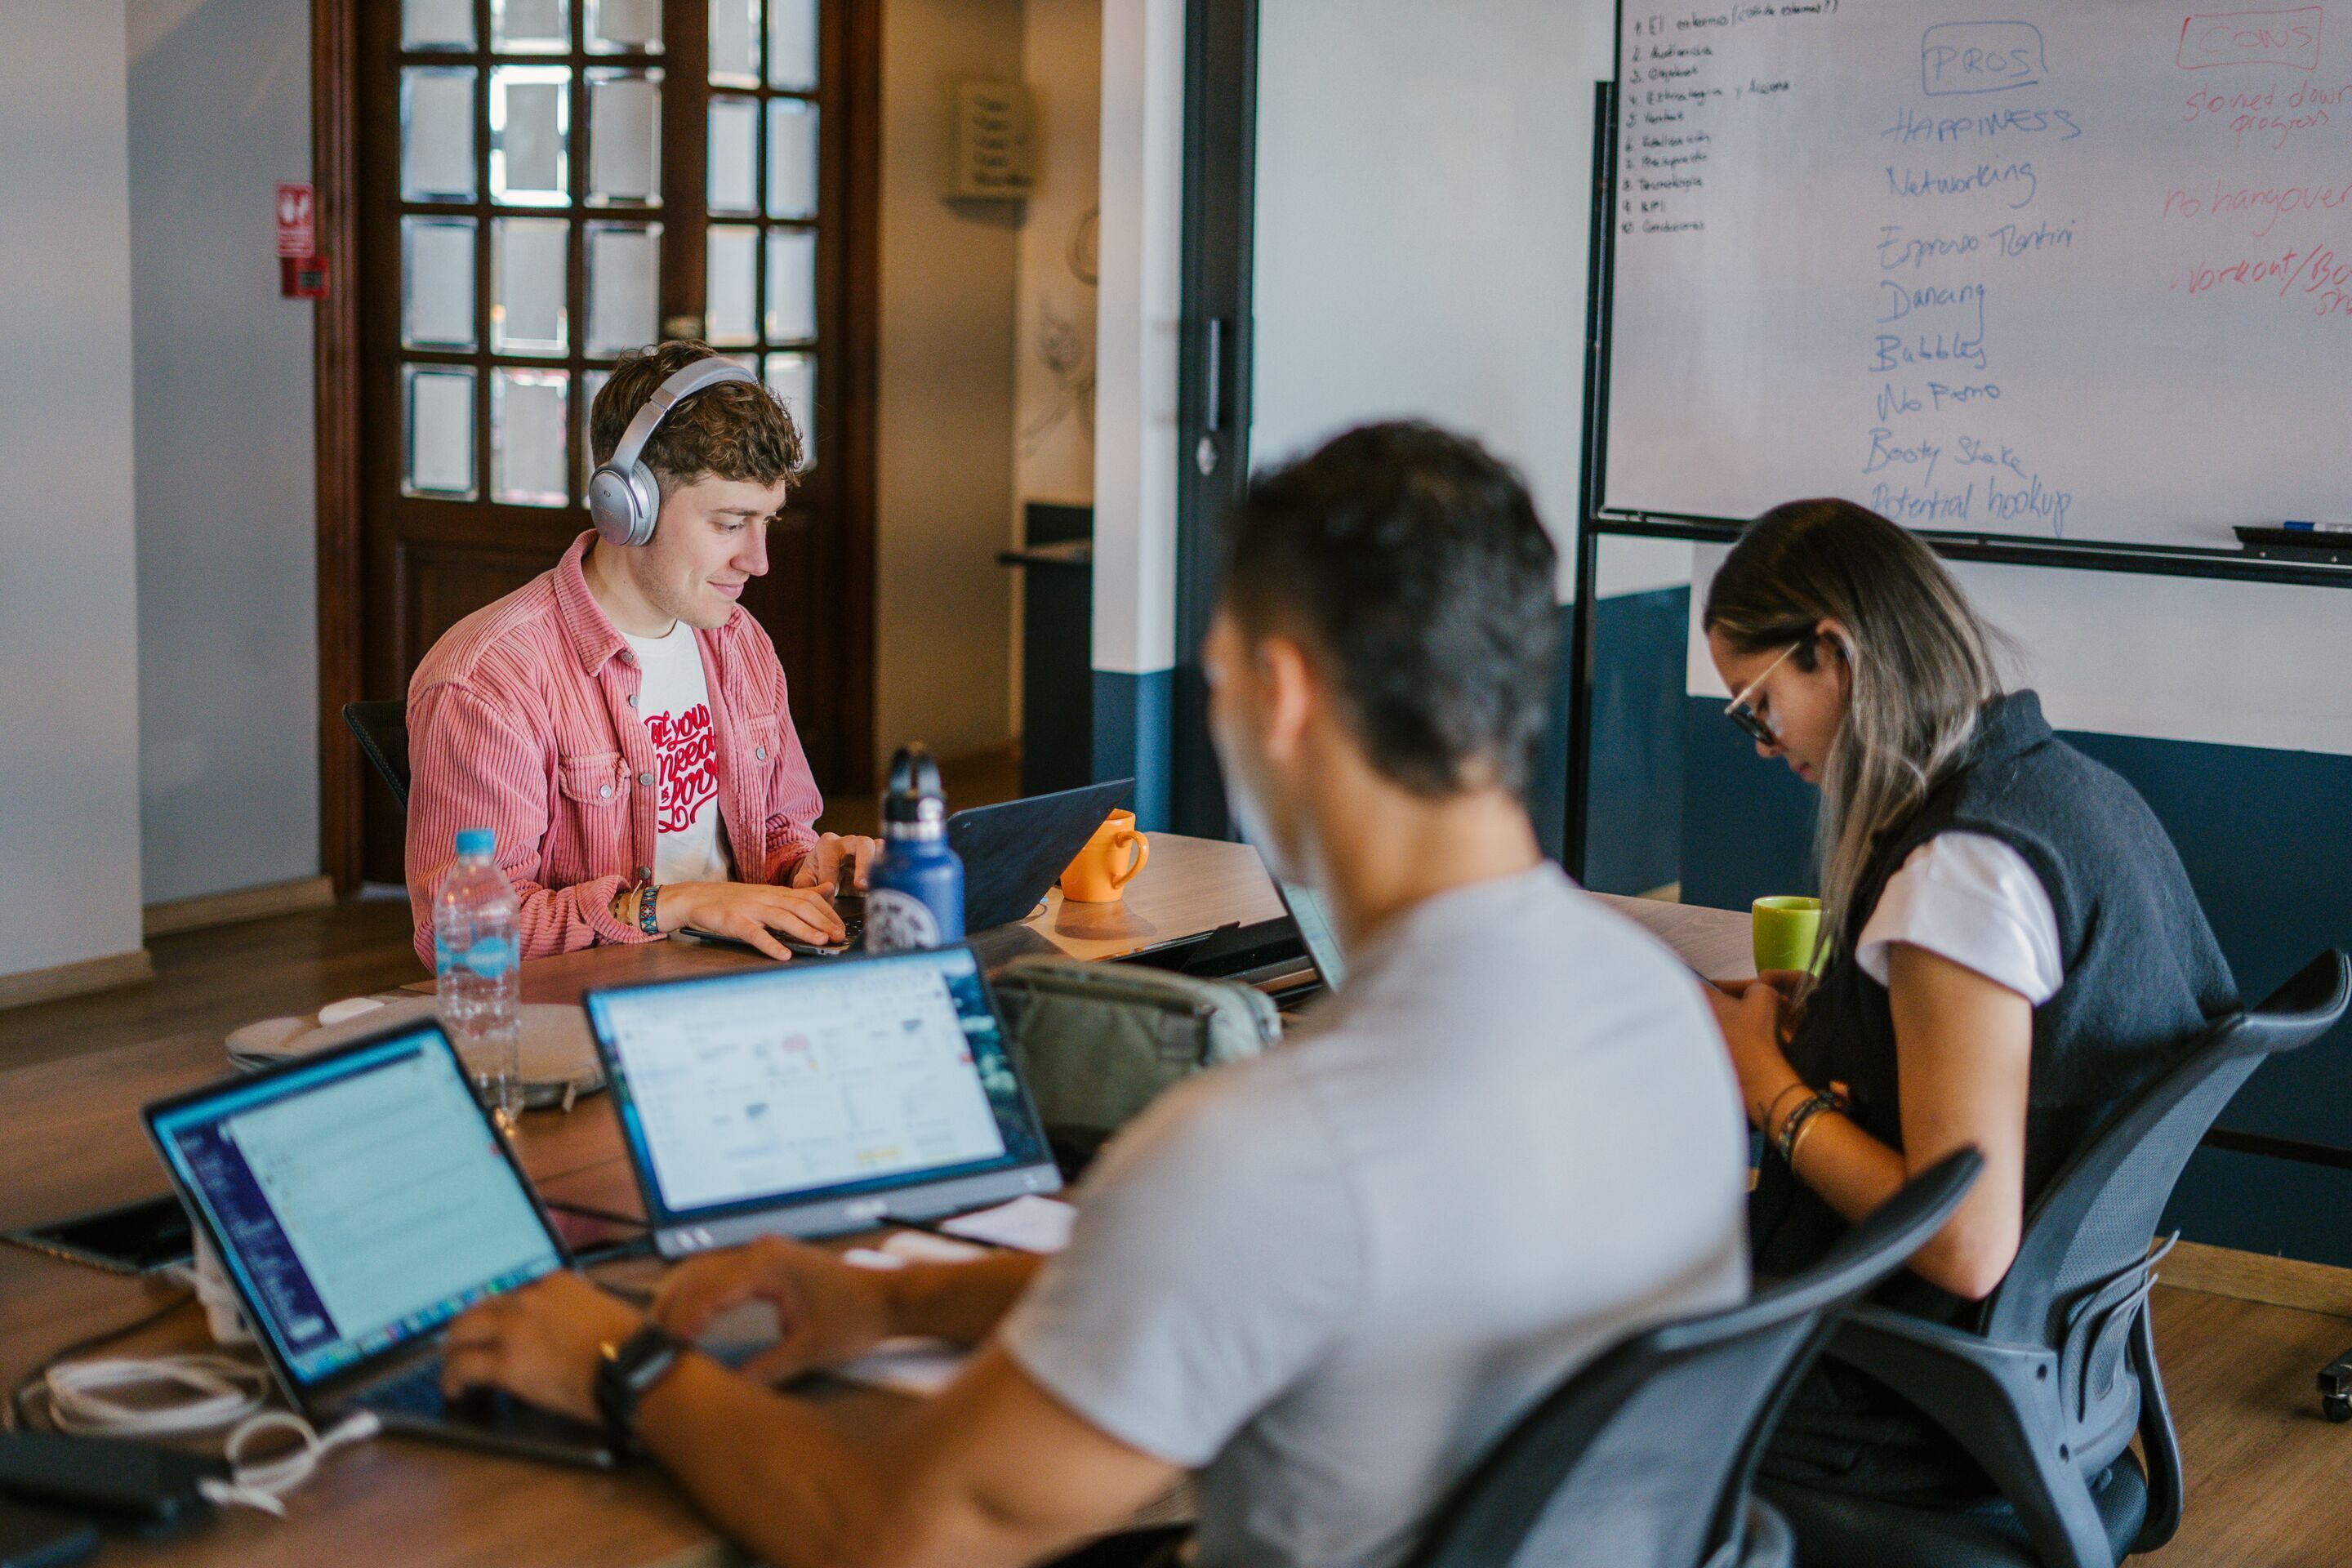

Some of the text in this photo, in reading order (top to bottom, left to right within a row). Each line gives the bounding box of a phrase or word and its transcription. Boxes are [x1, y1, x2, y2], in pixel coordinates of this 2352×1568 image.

[1648, 13, 1664, 36] El
[2198, 25, 2313, 53] CONS
[1922, 44, 2032, 81] PROS
[1881, 105, 2082, 144] HAPPINESS
[2229, 109, 2330, 150] progress
[1885, 155, 2037, 209] Networking
[1876, 278, 1987, 346] Dancing
[1868, 332, 1988, 372] Bubbles
[1877, 381, 1922, 422] No
[1861, 426, 2027, 488] Booty Shake
[1871, 473, 2072, 538] Potential hookup
